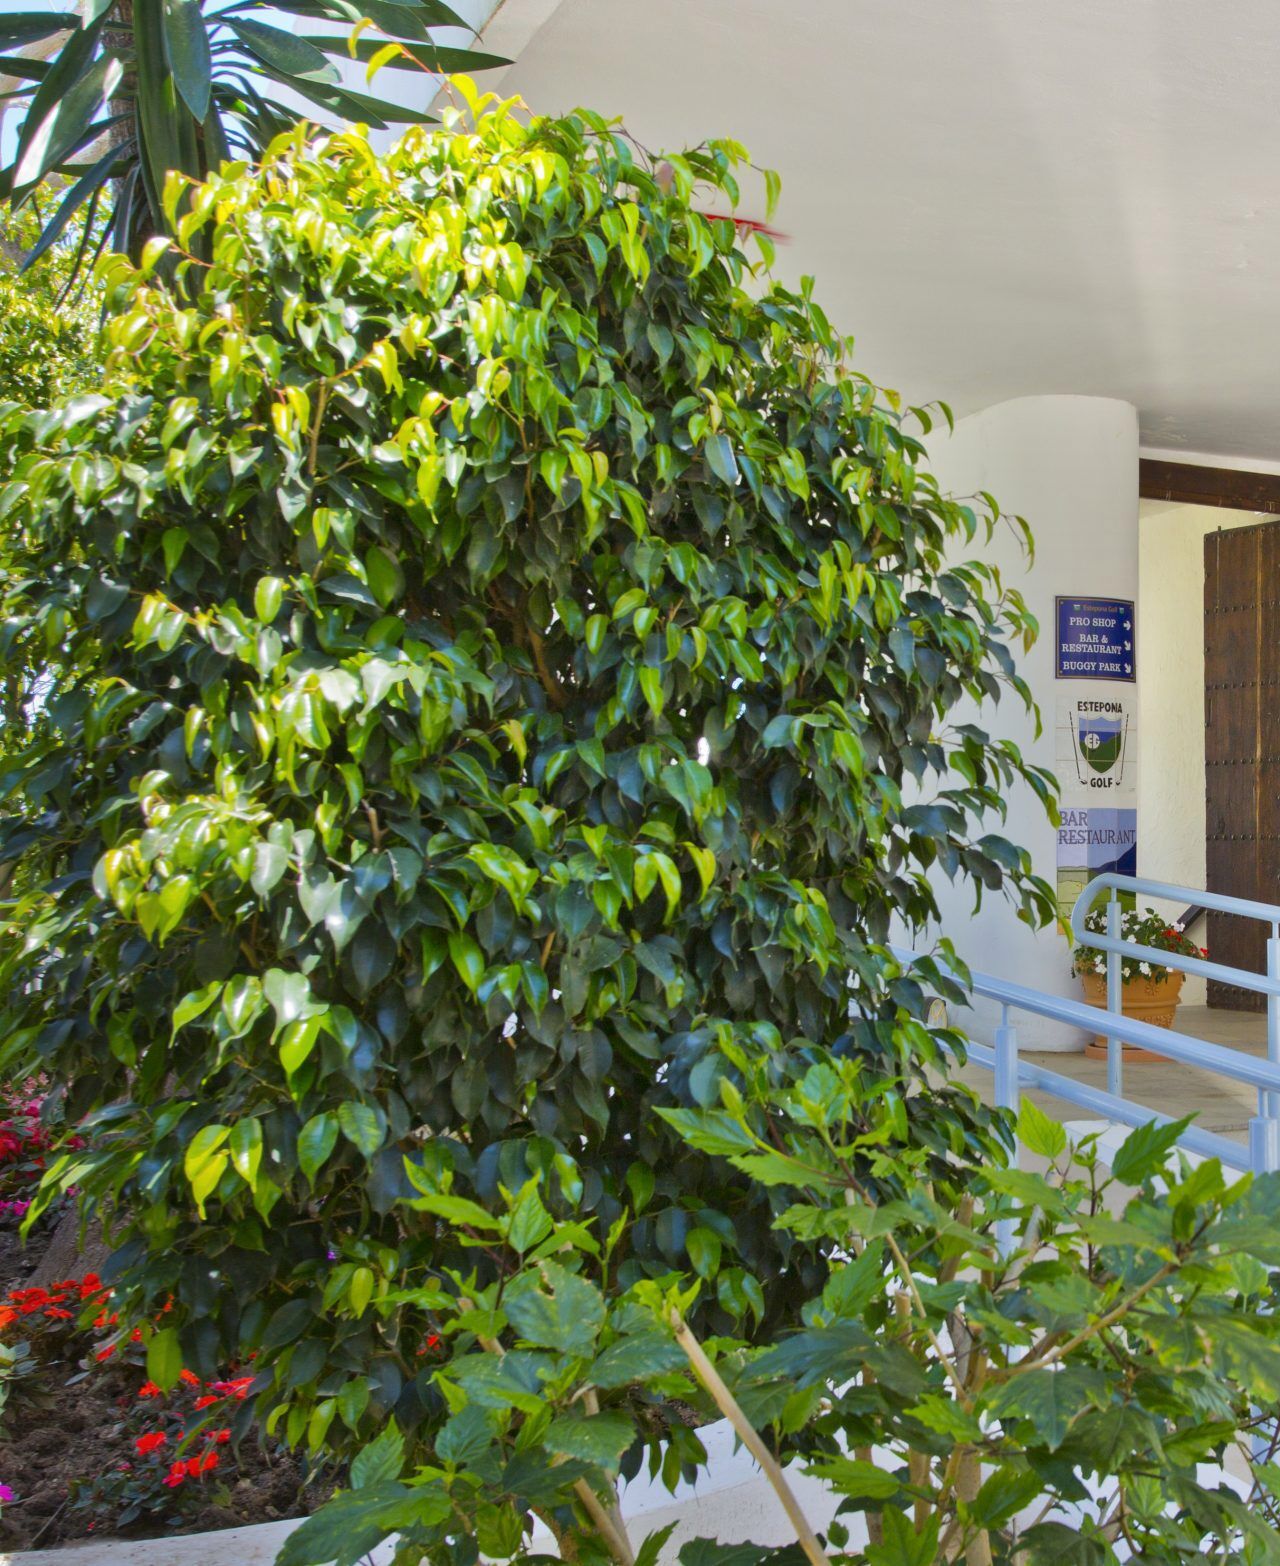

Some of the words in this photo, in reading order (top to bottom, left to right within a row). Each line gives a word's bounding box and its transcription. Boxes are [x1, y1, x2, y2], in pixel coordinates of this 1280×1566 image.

[1069, 617, 1090, 626] PRO
[1092, 618, 1116, 628] SHOP
[1079, 633, 1099, 643] BAR
[1101, 634, 1108, 643] &
[1061, 643, 1122, 655] RESTAURANT
[1063, 661, 1097, 671] BUGGY
[1099, 662, 1121, 672] PARK
[1077, 701, 1123, 713] ESTEPONA
[1090, 777, 1113, 788] GOLF
[1059, 810, 1088, 827] BAR
[1058, 829, 1136, 845] RESTAURANT
